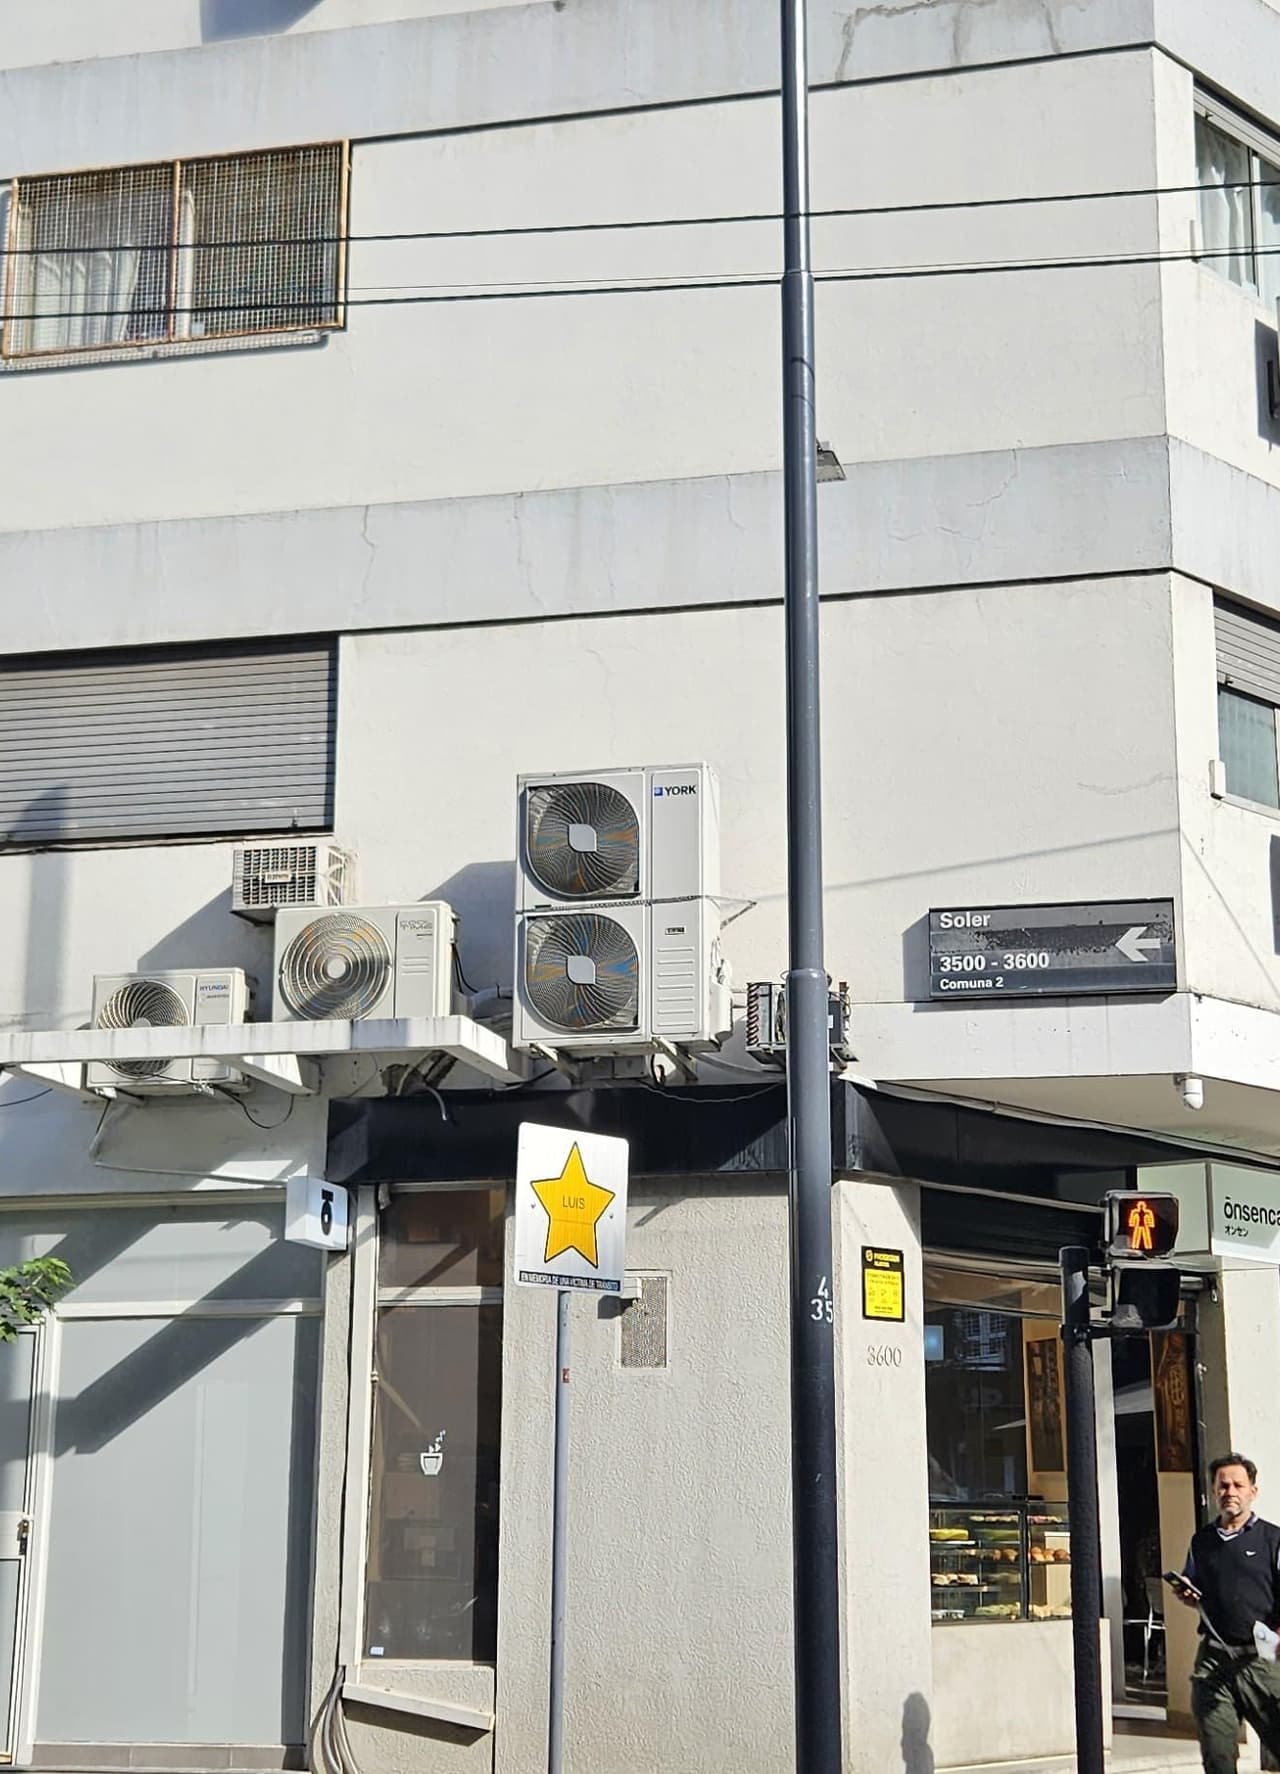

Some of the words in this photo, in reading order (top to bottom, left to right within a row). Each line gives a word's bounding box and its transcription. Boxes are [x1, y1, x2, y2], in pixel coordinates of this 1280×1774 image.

[664, 785, 696, 796] YORK
[939, 912, 991, 929] Soler
[939, 955, 986, 972] 3500
[1003, 953, 1050, 970] 3600
[939, 979, 993, 990] Comuna
[995, 977, 1004, 988] 2
[562, 1195, 586, 1210] LUIS
[818, 1276, 829, 1299] 4
[867, 1344, 902, 1368] 3600
